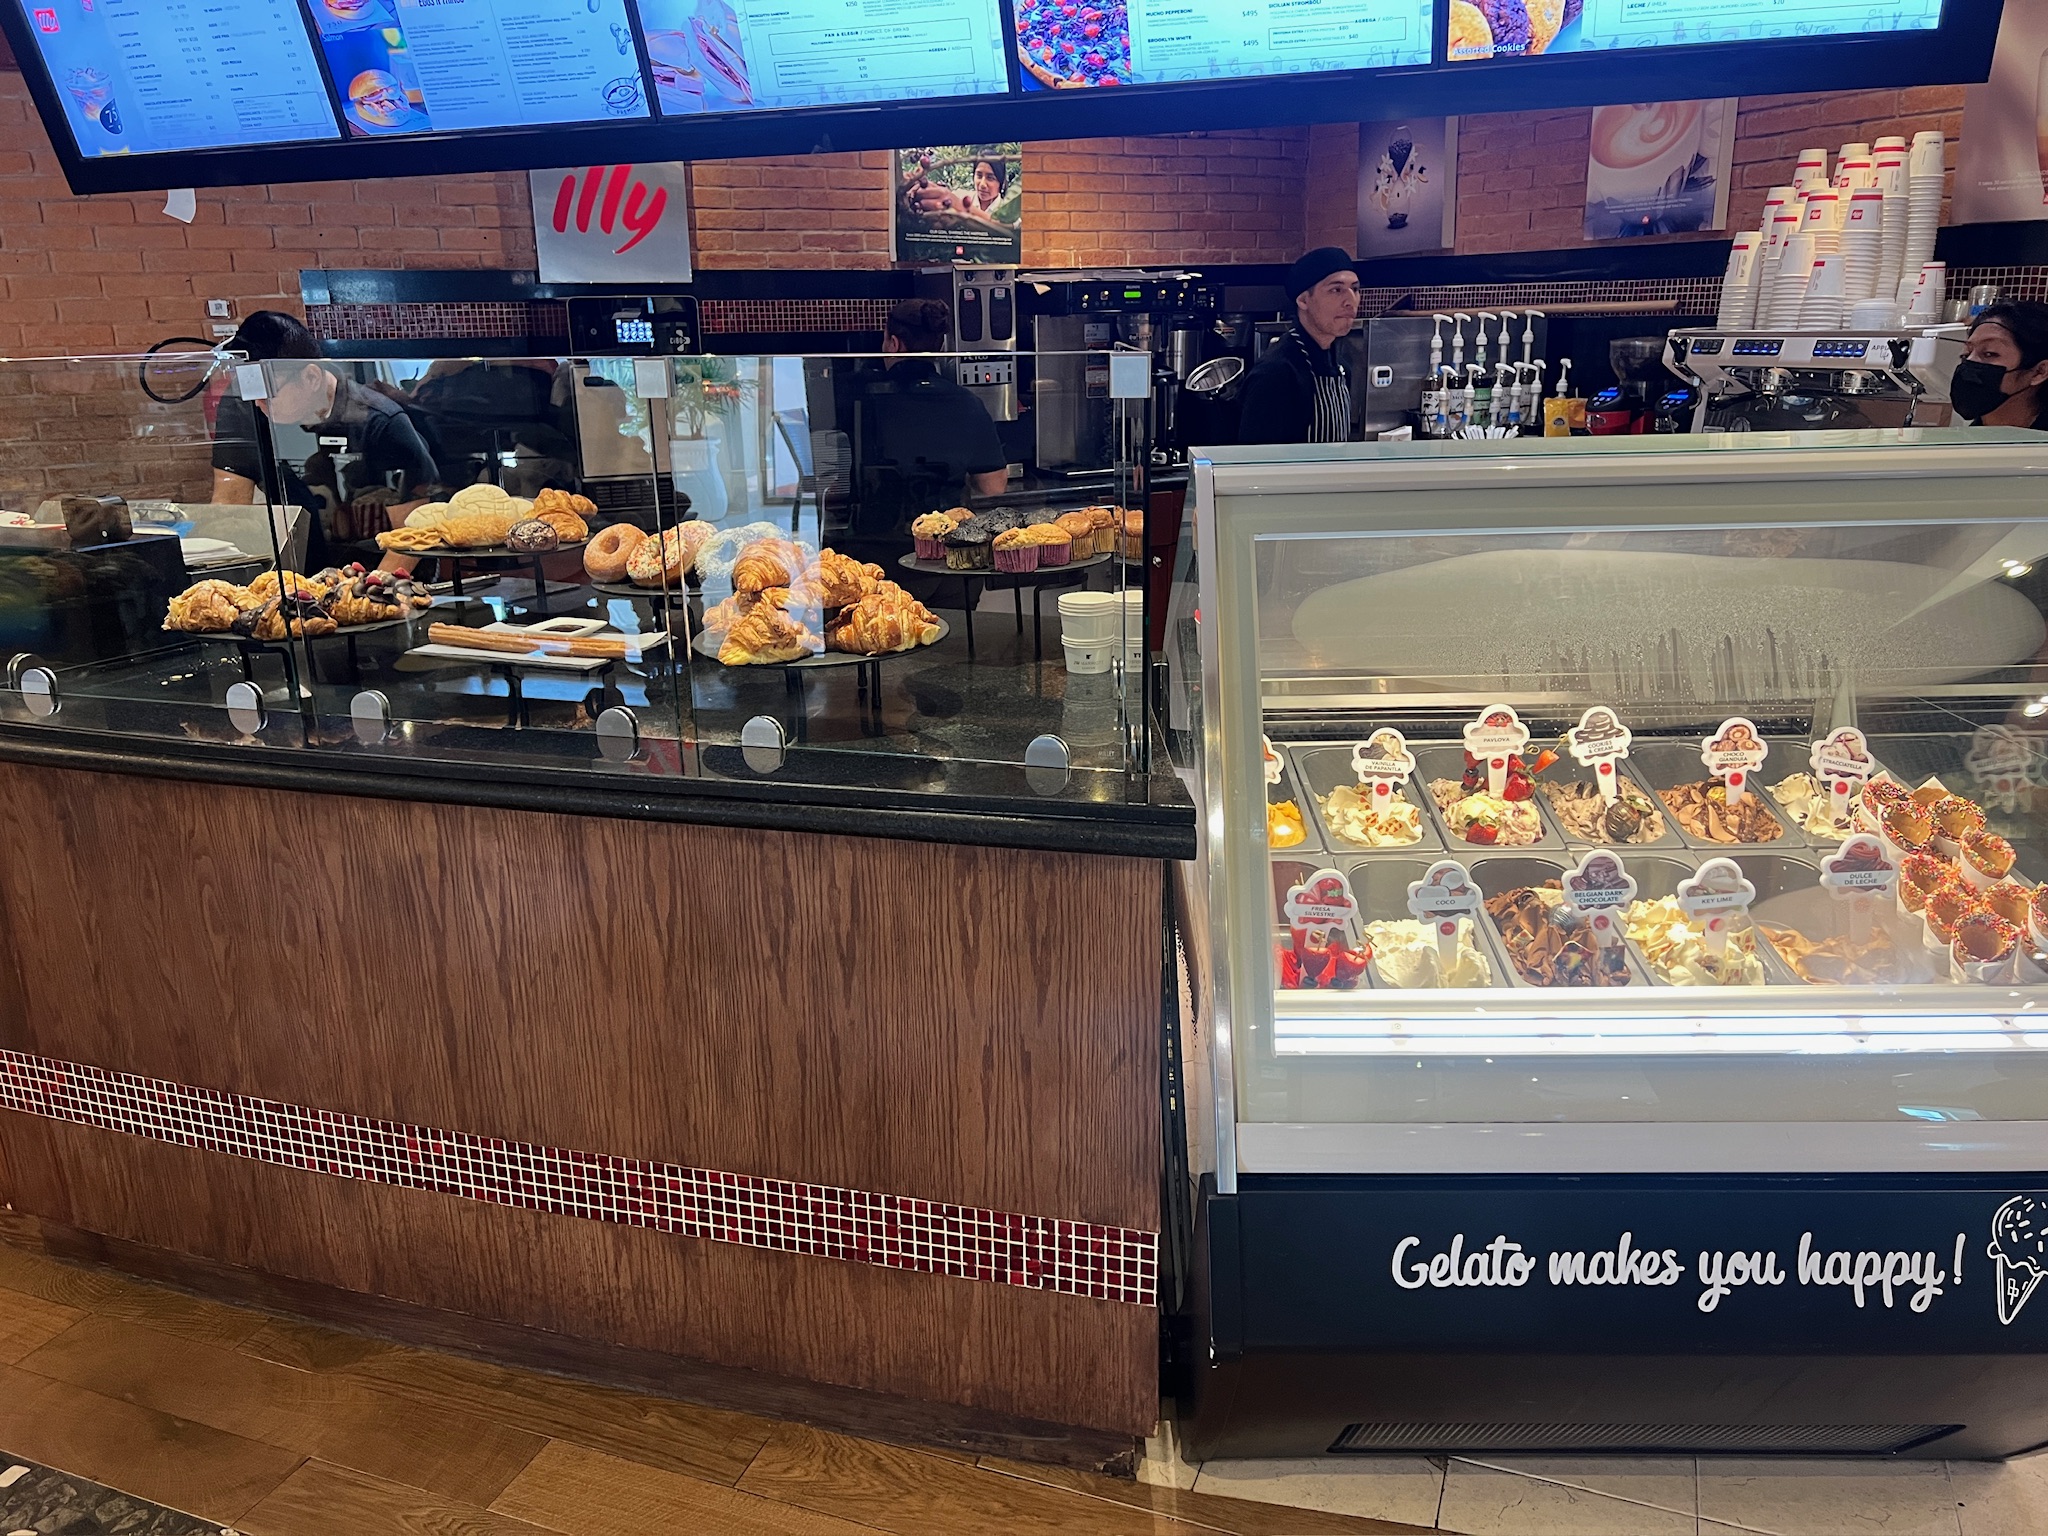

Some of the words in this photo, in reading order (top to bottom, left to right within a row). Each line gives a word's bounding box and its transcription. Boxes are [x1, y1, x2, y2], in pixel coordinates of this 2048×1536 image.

[1454, 47, 1491, 56] Assorted
[1491, 44, 1526, 53] Cookies
[554, 164, 667, 254] illy
[1588, 740, 1612, 749] COOKIES
[1823, 759, 1862, 770] STRACCIATELLA
[1391, 1233, 1537, 1288] Gelato
[1548, 1231, 1685, 1285] makes
[1697, 1250, 1785, 1312] you
